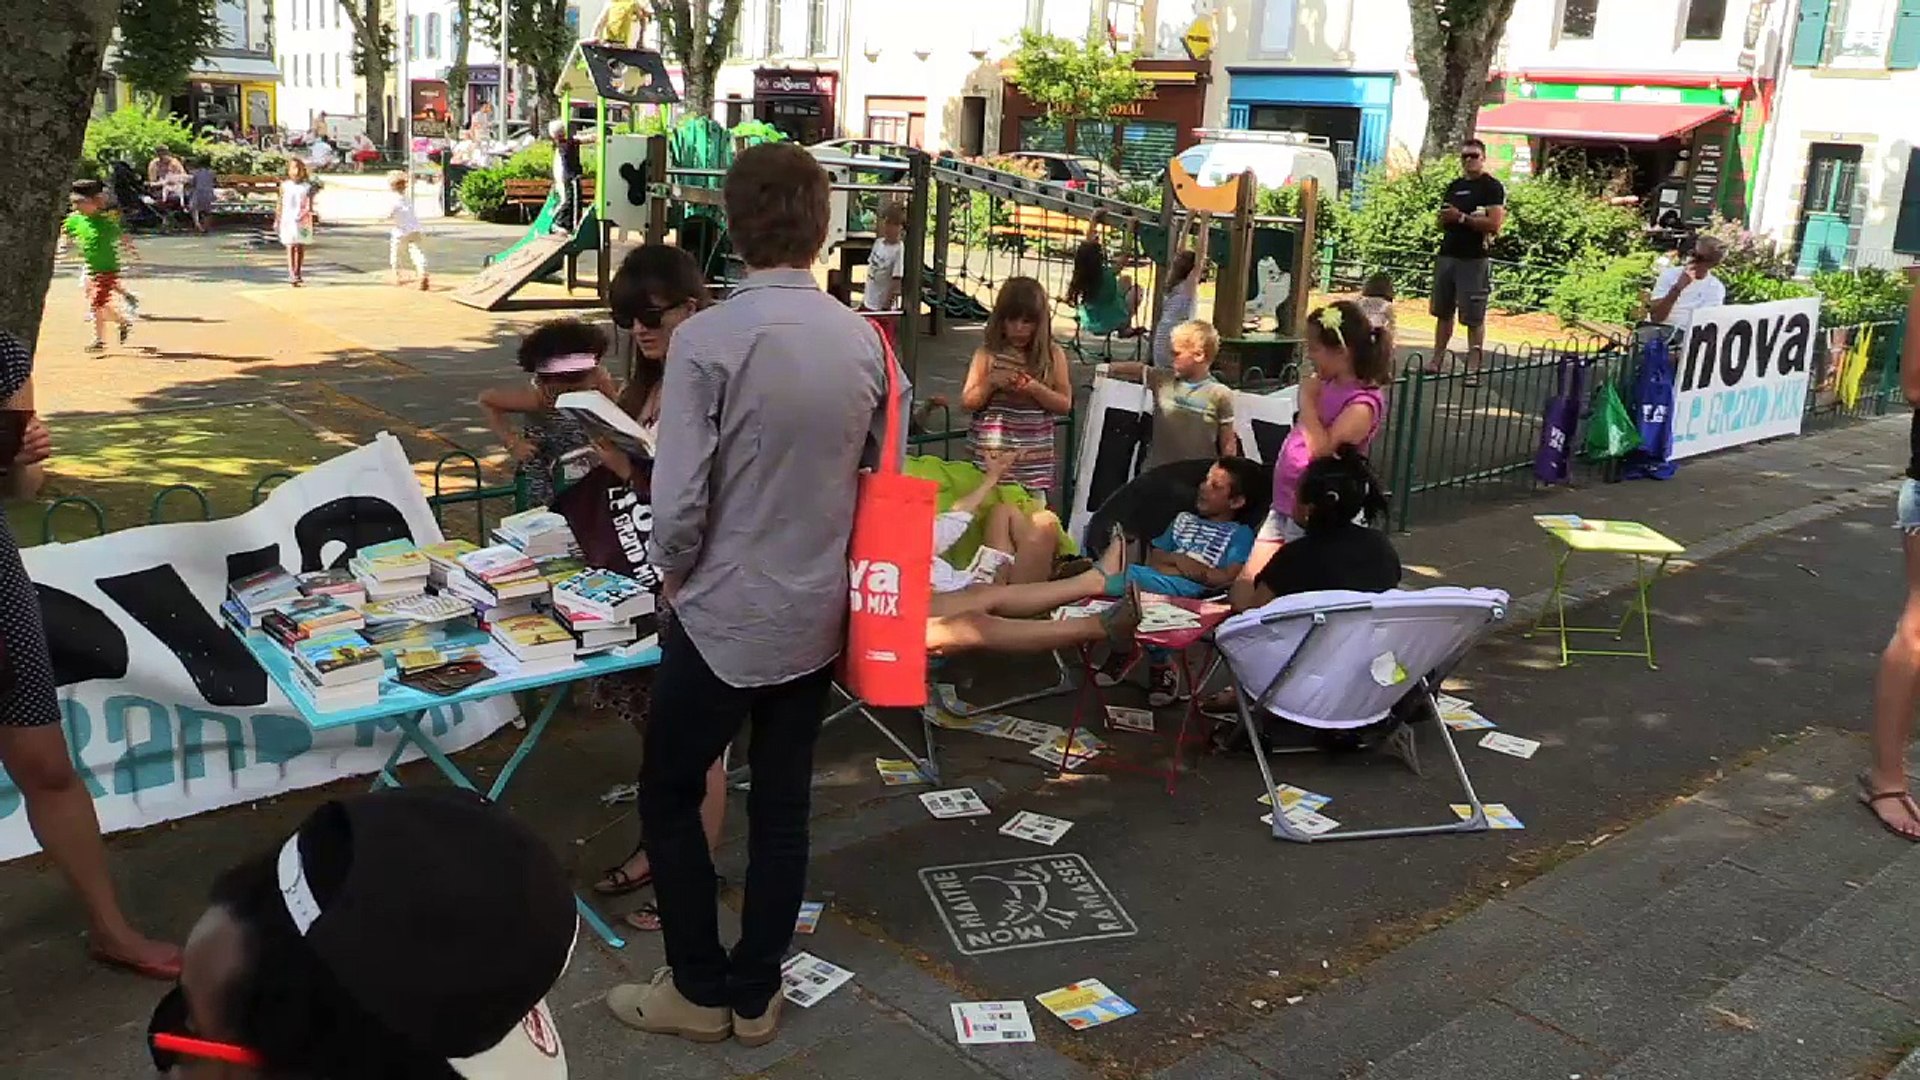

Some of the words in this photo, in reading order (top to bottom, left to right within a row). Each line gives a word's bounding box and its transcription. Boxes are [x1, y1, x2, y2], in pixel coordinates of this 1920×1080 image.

[1681, 312, 1810, 392] nova
[867, 593, 898, 616] MIX
[933, 870, 986, 929] MAITRE
[1050, 858, 1124, 932] RAMASSE
[966, 924, 1046, 947] MON
